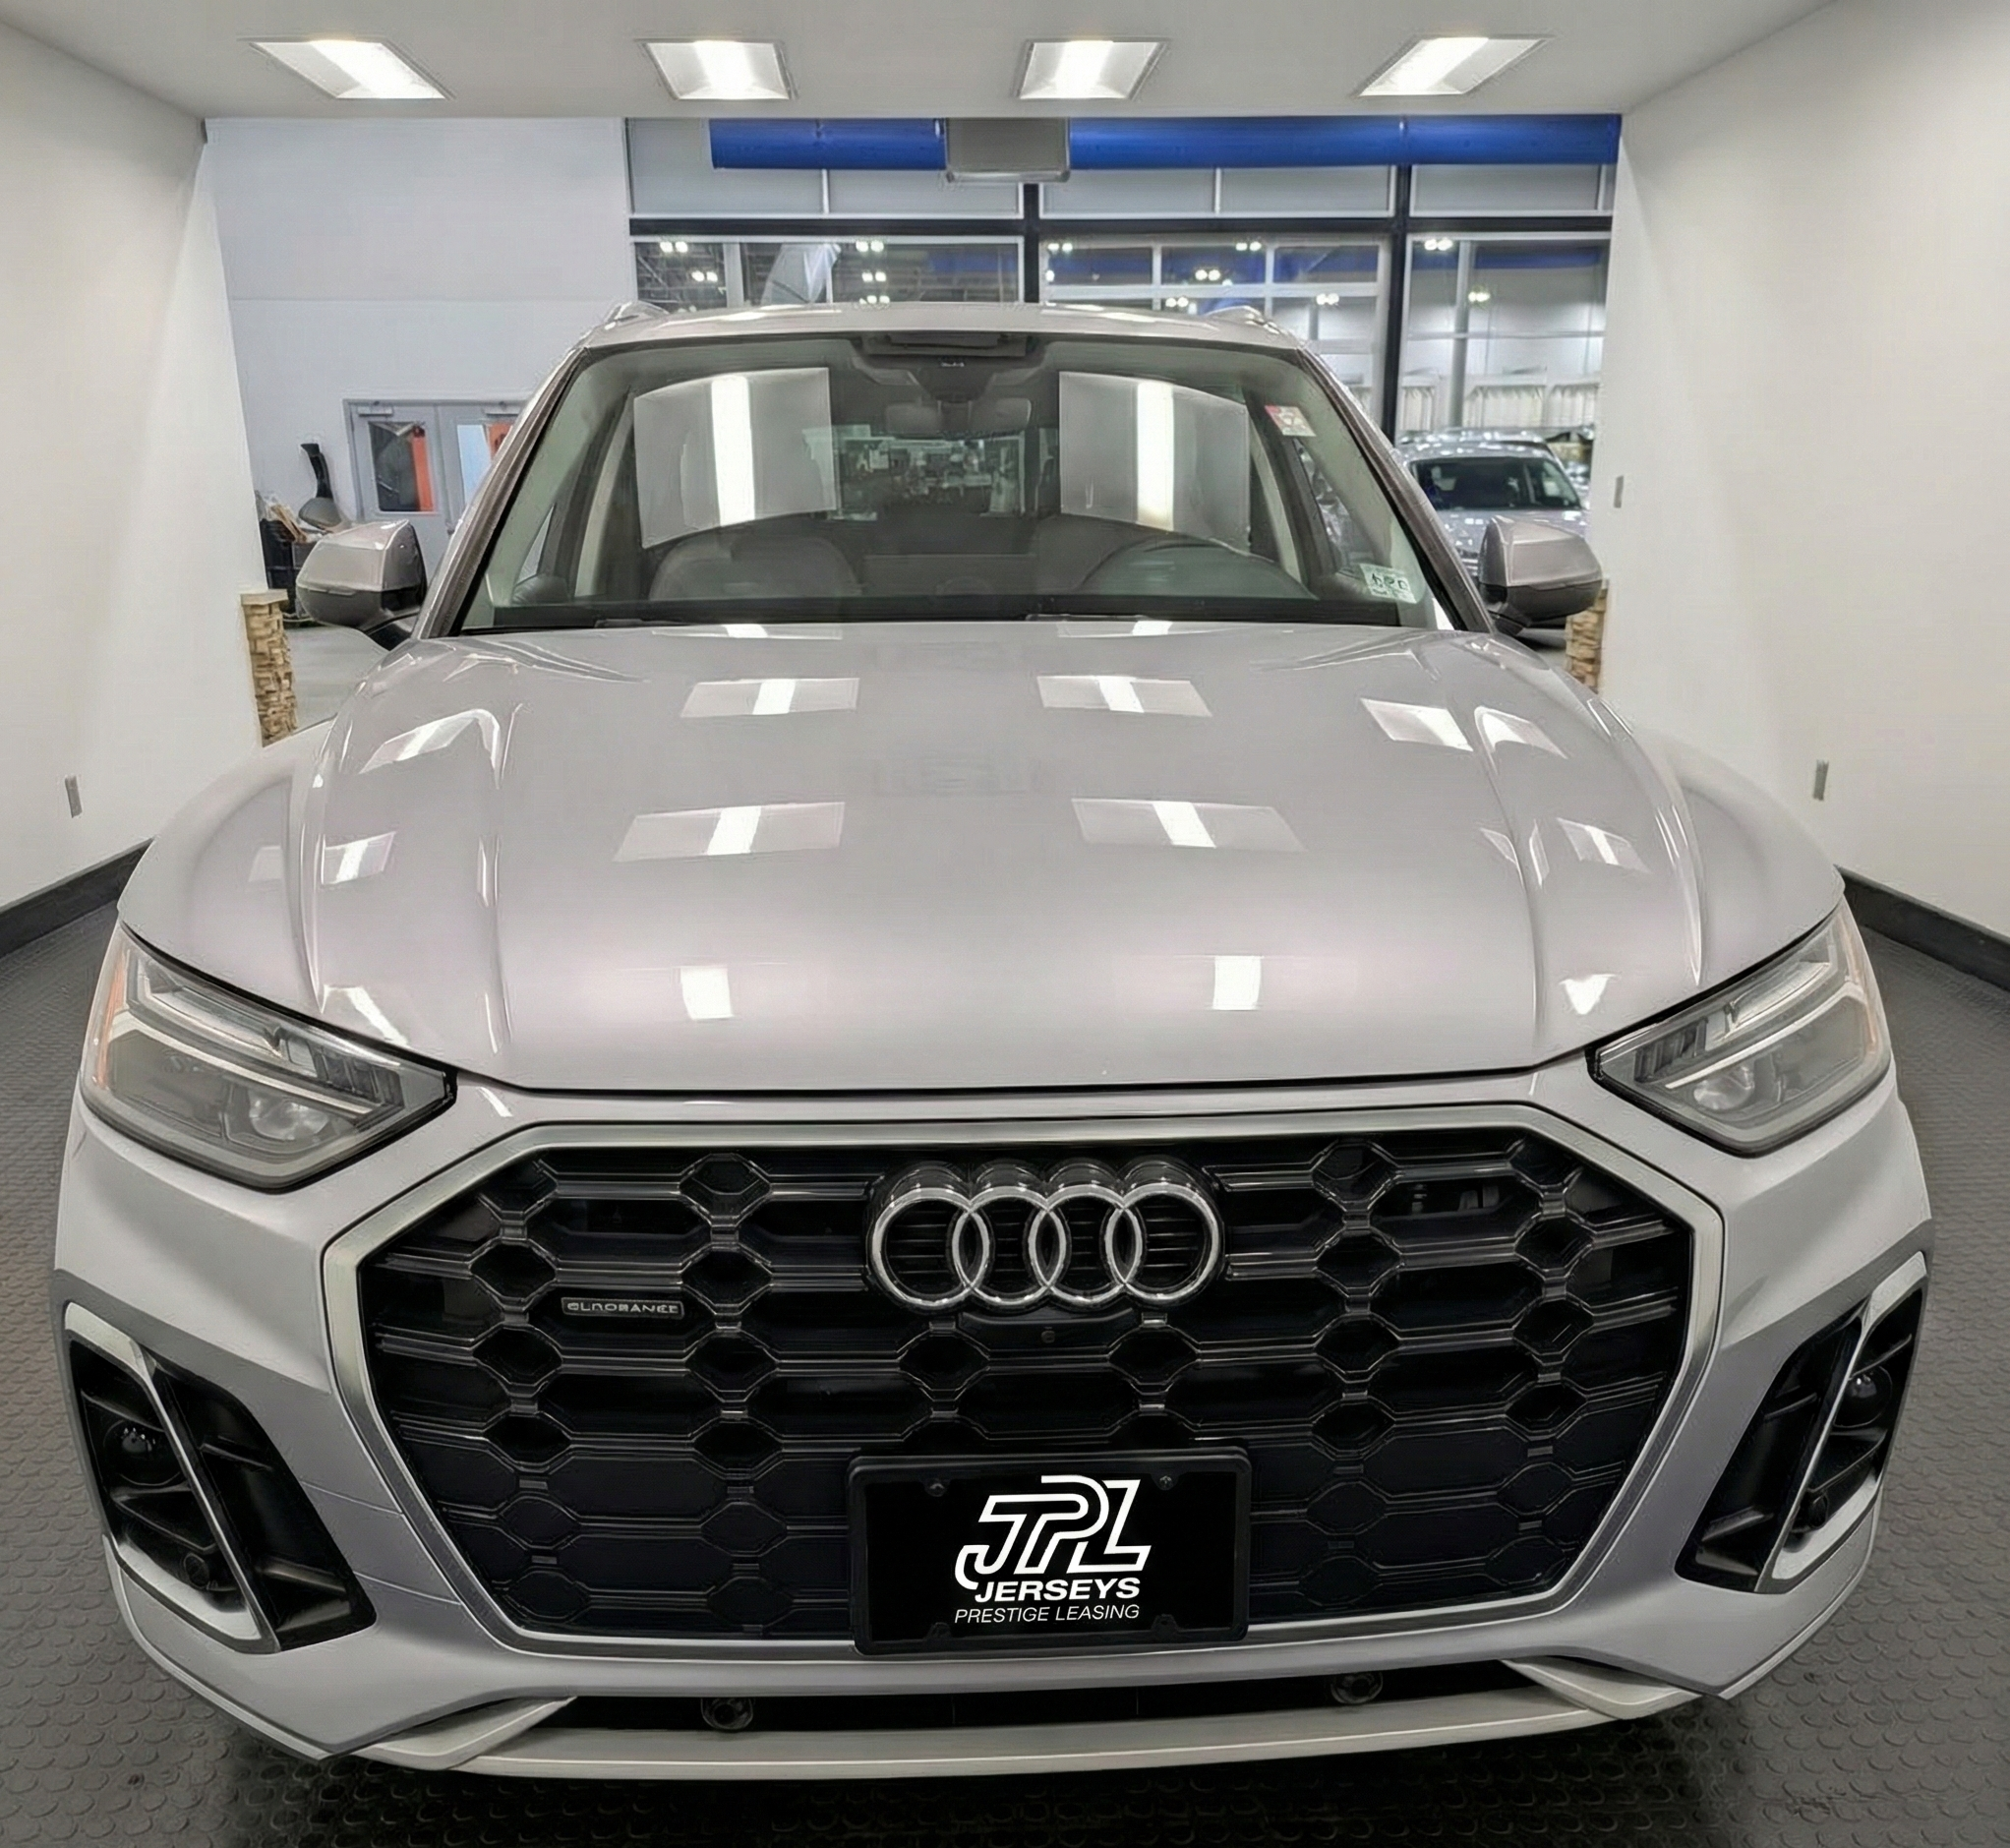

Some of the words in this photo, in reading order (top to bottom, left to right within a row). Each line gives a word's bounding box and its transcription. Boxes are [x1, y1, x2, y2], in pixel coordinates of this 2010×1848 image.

[974, 1577, 1141, 1603] JERSEYS
[954, 1606, 1051, 1624] PRESTIGE
[1055, 1603, 1140, 1622] LEASING
